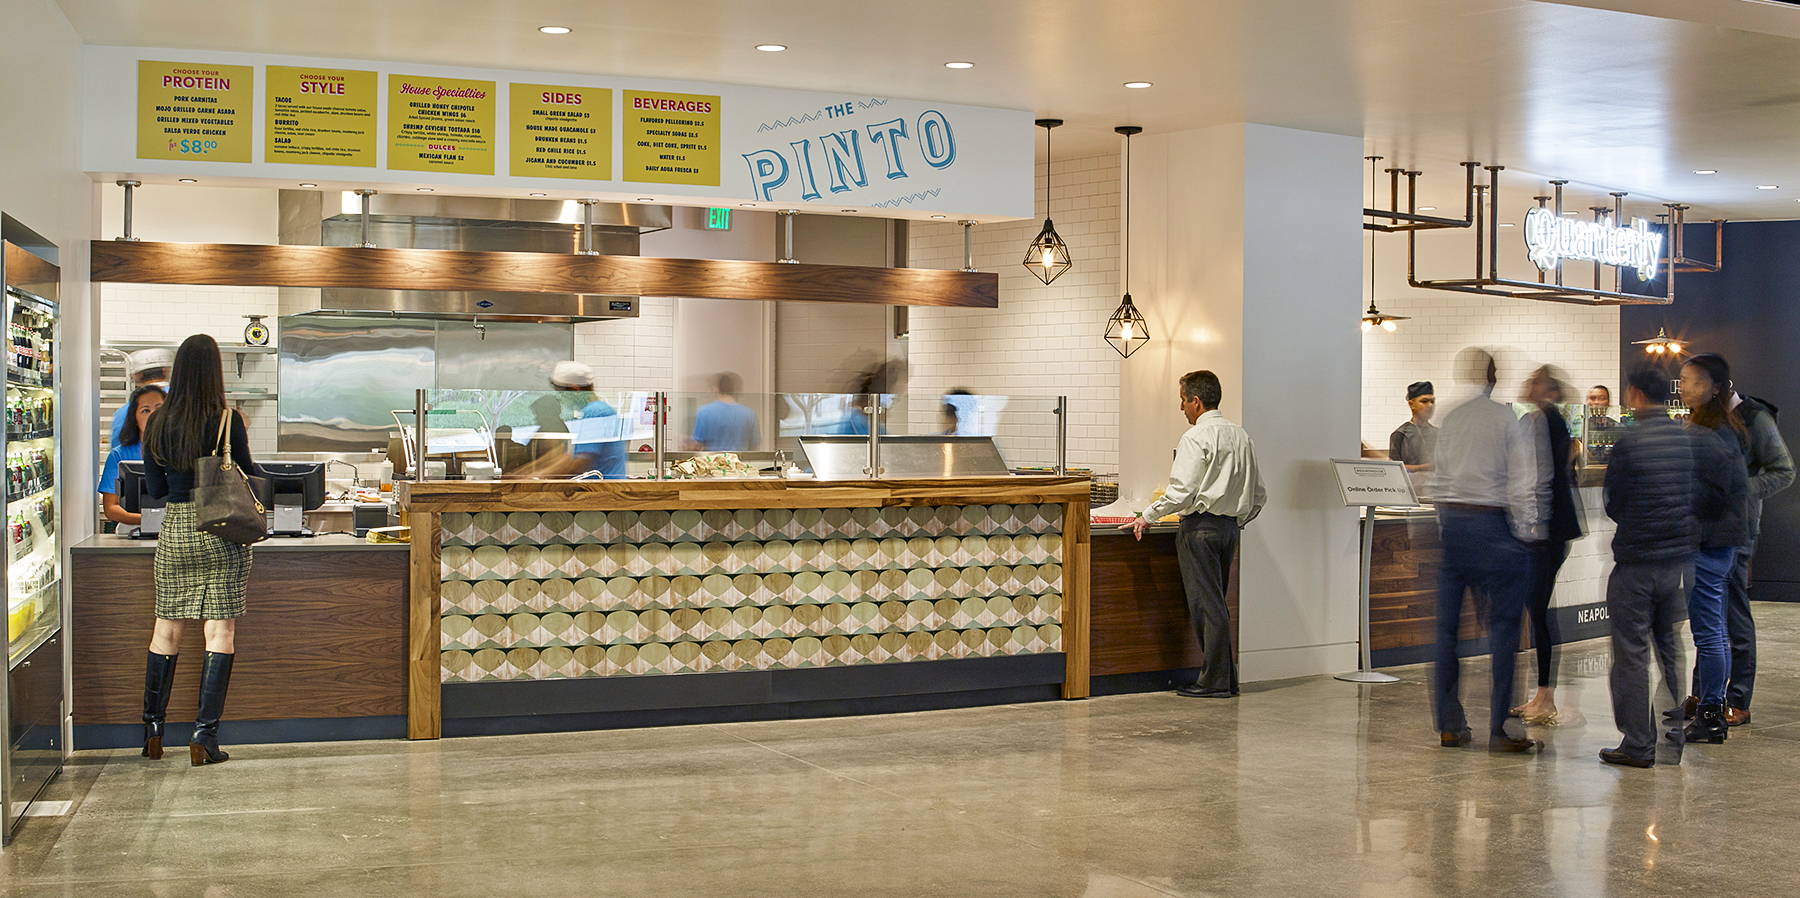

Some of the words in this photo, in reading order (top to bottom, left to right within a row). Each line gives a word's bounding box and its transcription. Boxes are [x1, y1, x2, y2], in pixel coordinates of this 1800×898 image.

[163, 75, 230, 91] PROTEIN
[300, 81, 345, 95] STYLE
[399, 83, 431, 96] House
[431, 86, 486, 101] Specialties
[541, 92, 582, 105] SIDES
[633, 97, 711, 114] BEVERAGES
[825, 102, 854, 119] THE
[741, 109, 957, 202] PINTO
[709, 207, 731, 230] EXIT
[1526, 208, 1662, 280] Quarterly
